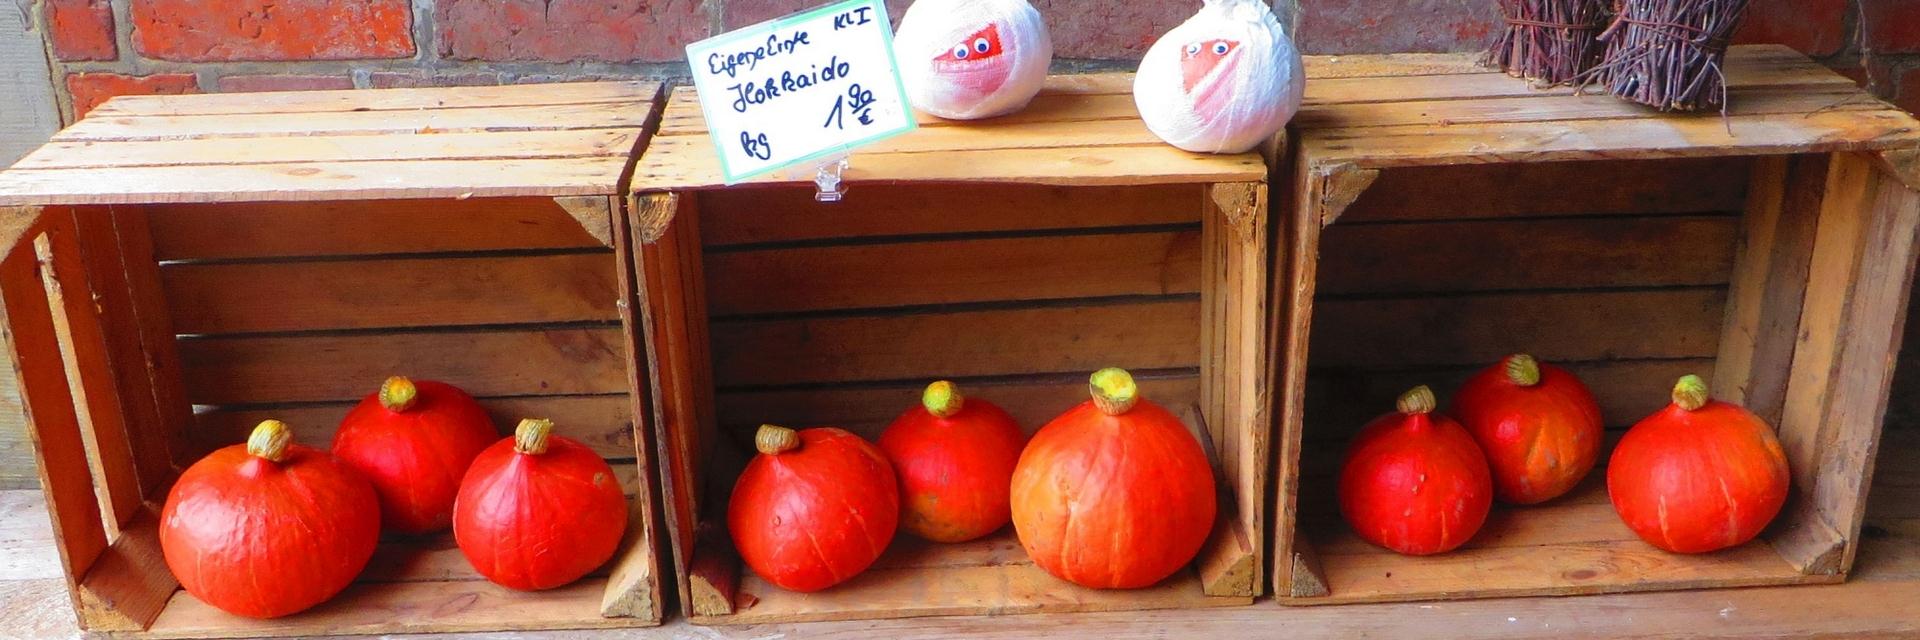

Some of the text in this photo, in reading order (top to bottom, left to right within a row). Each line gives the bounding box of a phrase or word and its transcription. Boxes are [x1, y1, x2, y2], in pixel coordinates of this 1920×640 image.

[708, 31, 810, 78] Eigene Ernte
[727, 55, 851, 113] Hokkaido
